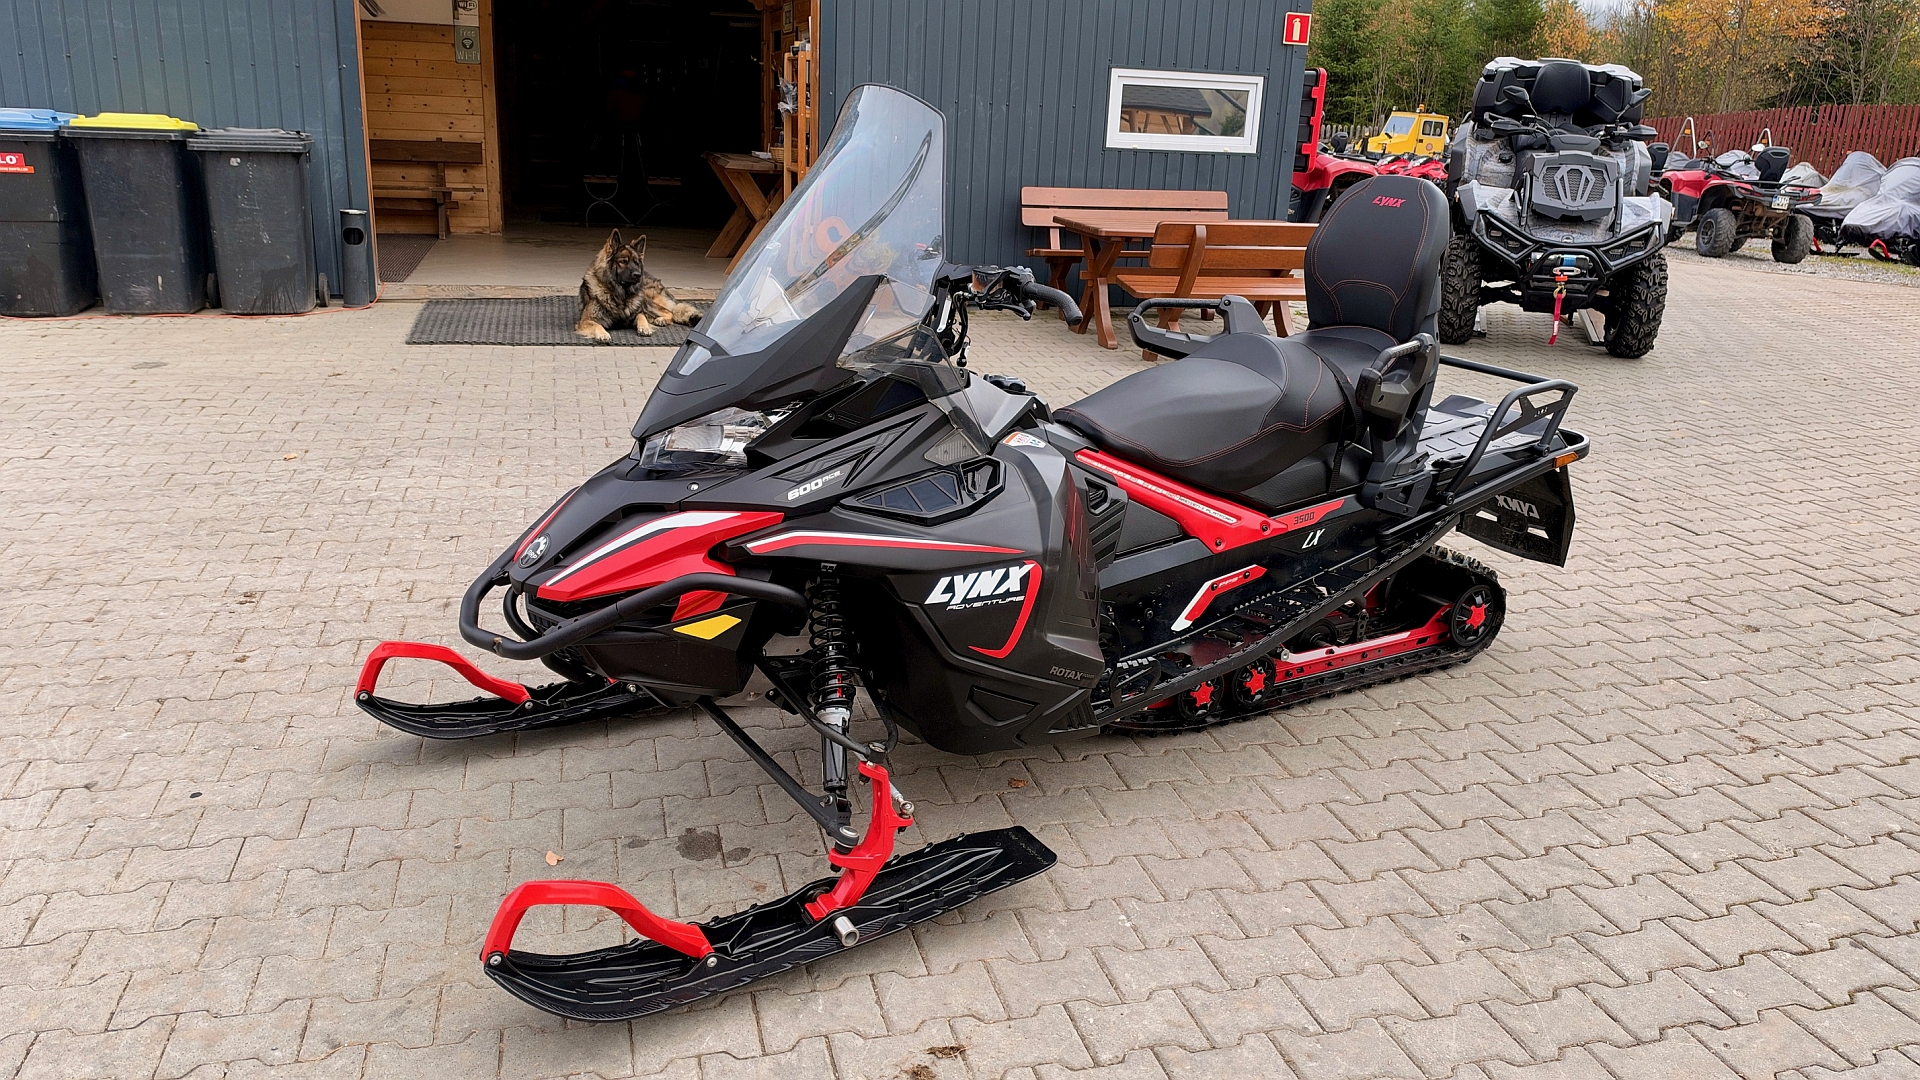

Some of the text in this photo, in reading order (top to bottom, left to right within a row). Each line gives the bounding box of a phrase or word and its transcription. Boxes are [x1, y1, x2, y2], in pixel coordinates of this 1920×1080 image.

[460, 29, 476, 37] Free
[457, 50, 480, 61] Wi-Fi
[1372, 195, 1407, 208] LYNX
[787, 478, 823, 501] 600
[1293, 511, 1315, 525] 3500
[1302, 528, 1326, 549] LX
[924, 563, 1036, 605] LYNX
[945, 595, 1026, 611] ADVENTURE
[1050, 665, 1083, 681] ROTAX
